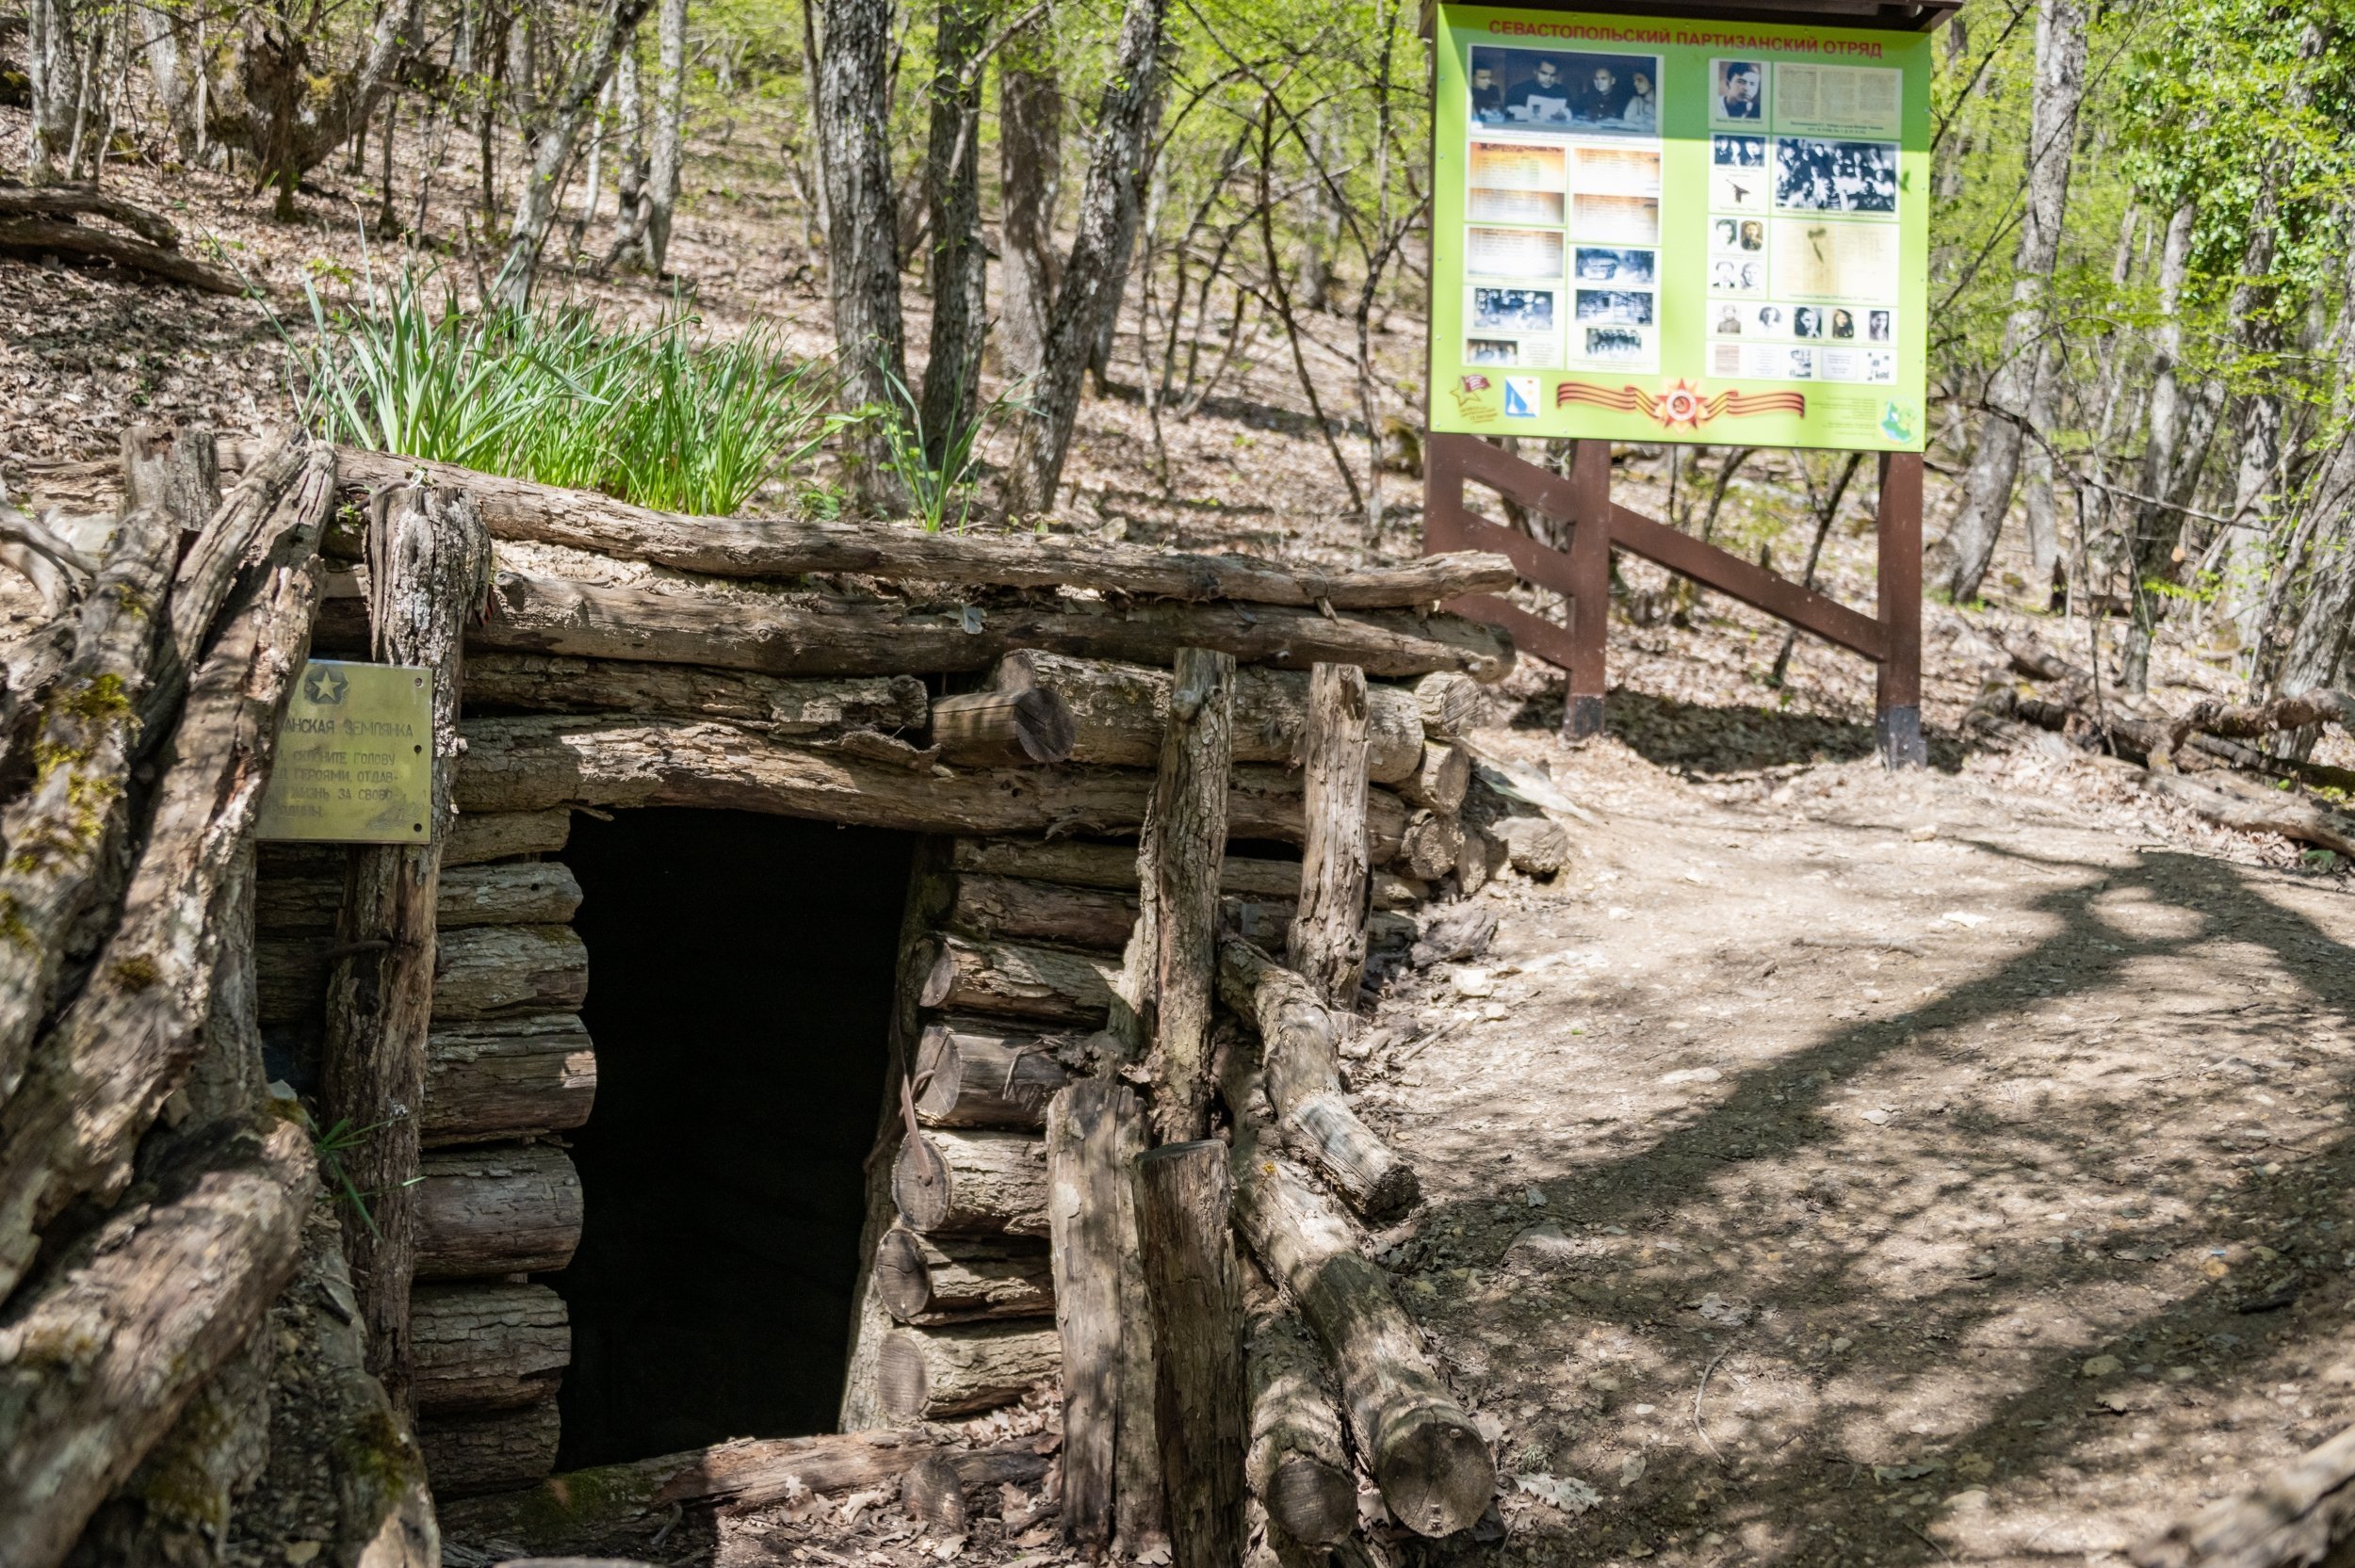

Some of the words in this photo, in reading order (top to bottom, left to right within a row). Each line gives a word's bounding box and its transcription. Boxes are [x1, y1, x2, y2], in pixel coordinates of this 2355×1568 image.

[1488, 19, 1671, 45] СЕВАСТОПОЛЬСКИЙ
[1676, 30, 1818, 55] ПАРТИЗАНСКИЙ
[1823, 39, 1882, 59] ОТРЯД
[284, 718, 335, 735] АНСКАЯ
[343, 718, 414, 738] ЗЕМЛЯНКА
[353, 752, 396, 766] ГОЛОВУ
[337, 787, 352, 800] ЗА
